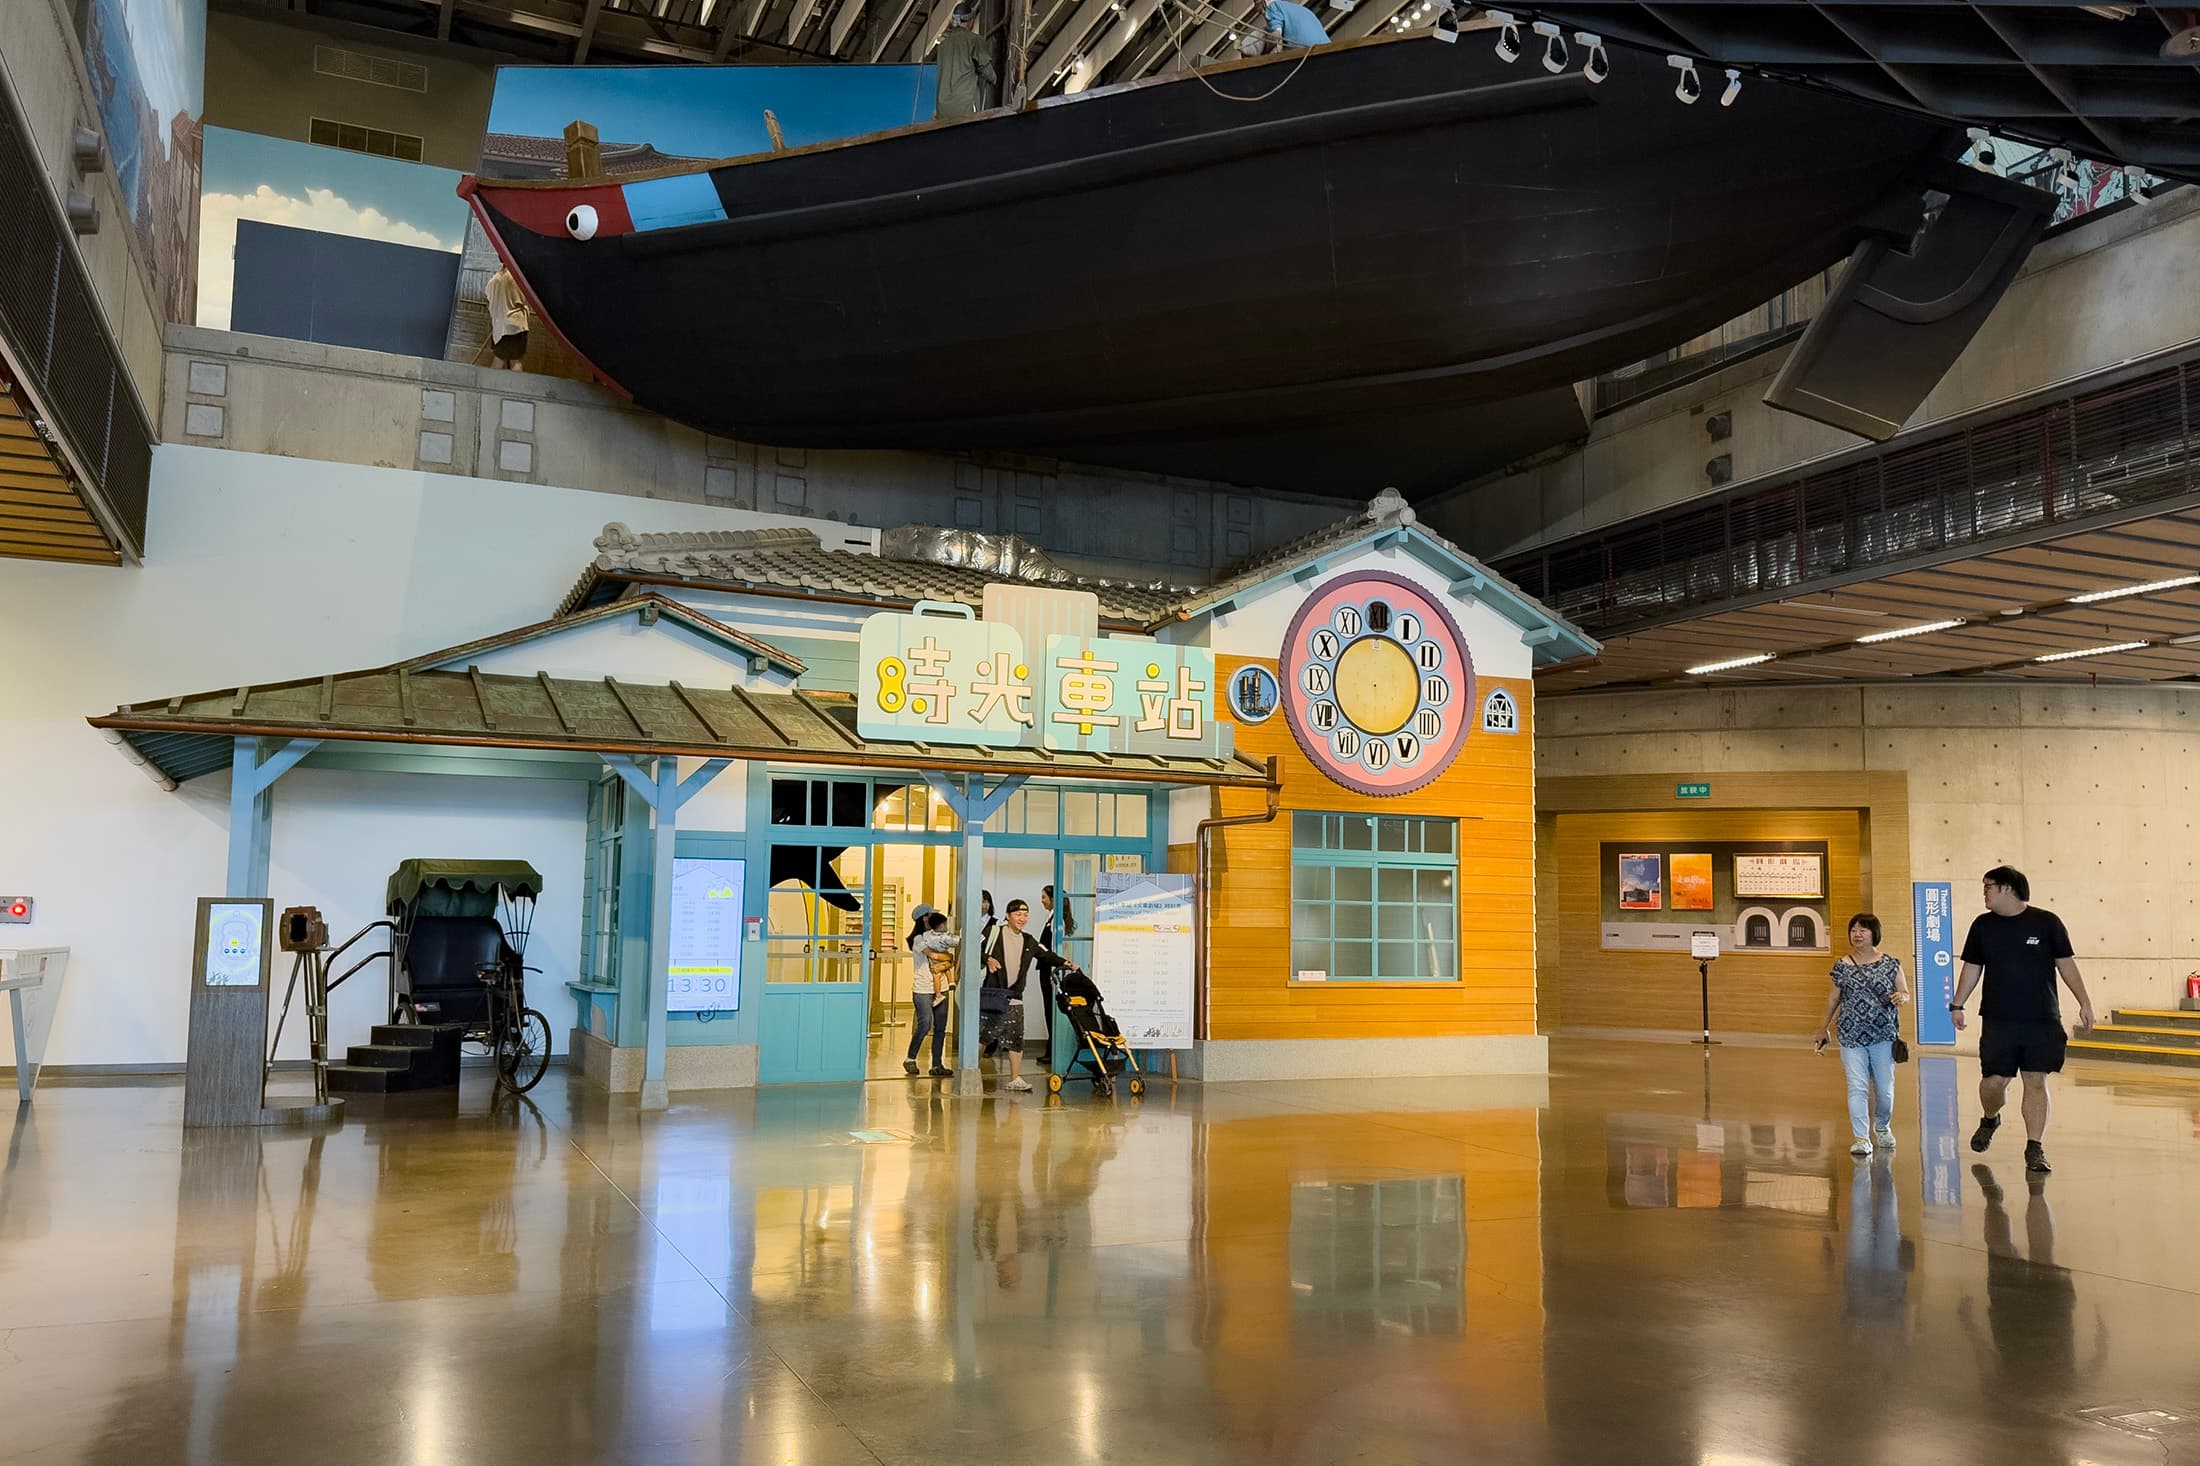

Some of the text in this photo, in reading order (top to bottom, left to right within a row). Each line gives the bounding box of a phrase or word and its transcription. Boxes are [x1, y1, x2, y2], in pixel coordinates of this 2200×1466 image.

[1341, 611, 1355, 634] XI
[1319, 635, 1332, 657] X
[1421, 647, 1434, 667] II
[877, 635, 1206, 740] 時光車站
[1309, 669, 1324, 691] IX
[1428, 680, 1441, 701] III
[1419, 713, 1435, 735] IIII
[1369, 744, 1383, 766] VI
[1398, 738, 1412, 758] V
